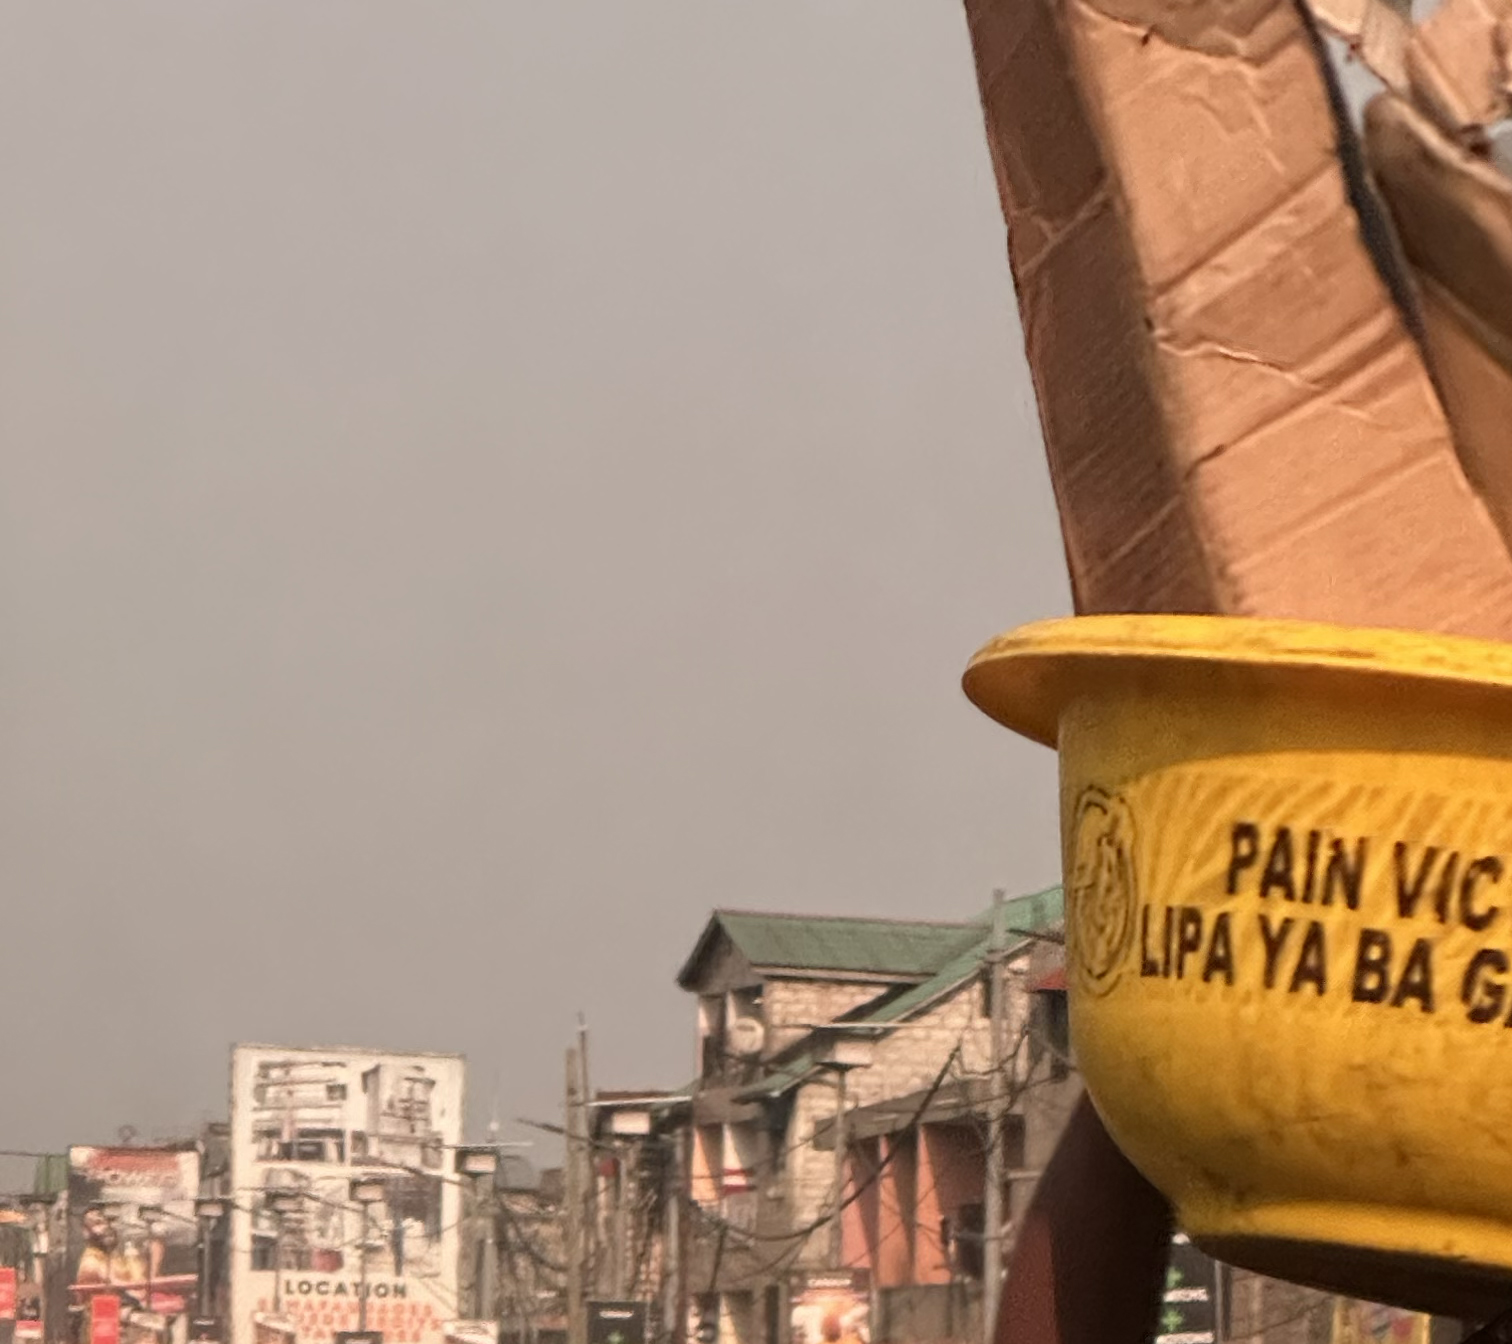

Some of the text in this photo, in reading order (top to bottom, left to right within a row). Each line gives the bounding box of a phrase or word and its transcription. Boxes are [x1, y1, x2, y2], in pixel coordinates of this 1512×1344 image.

[1226, 822, 1367, 911] PAIN
[1140, 903, 1235, 988] LIPA
[1258, 913, 1328, 997] YA
[1352, 928, 1435, 1014] BA
[284, 1279, 407, 1298] LOCATION
